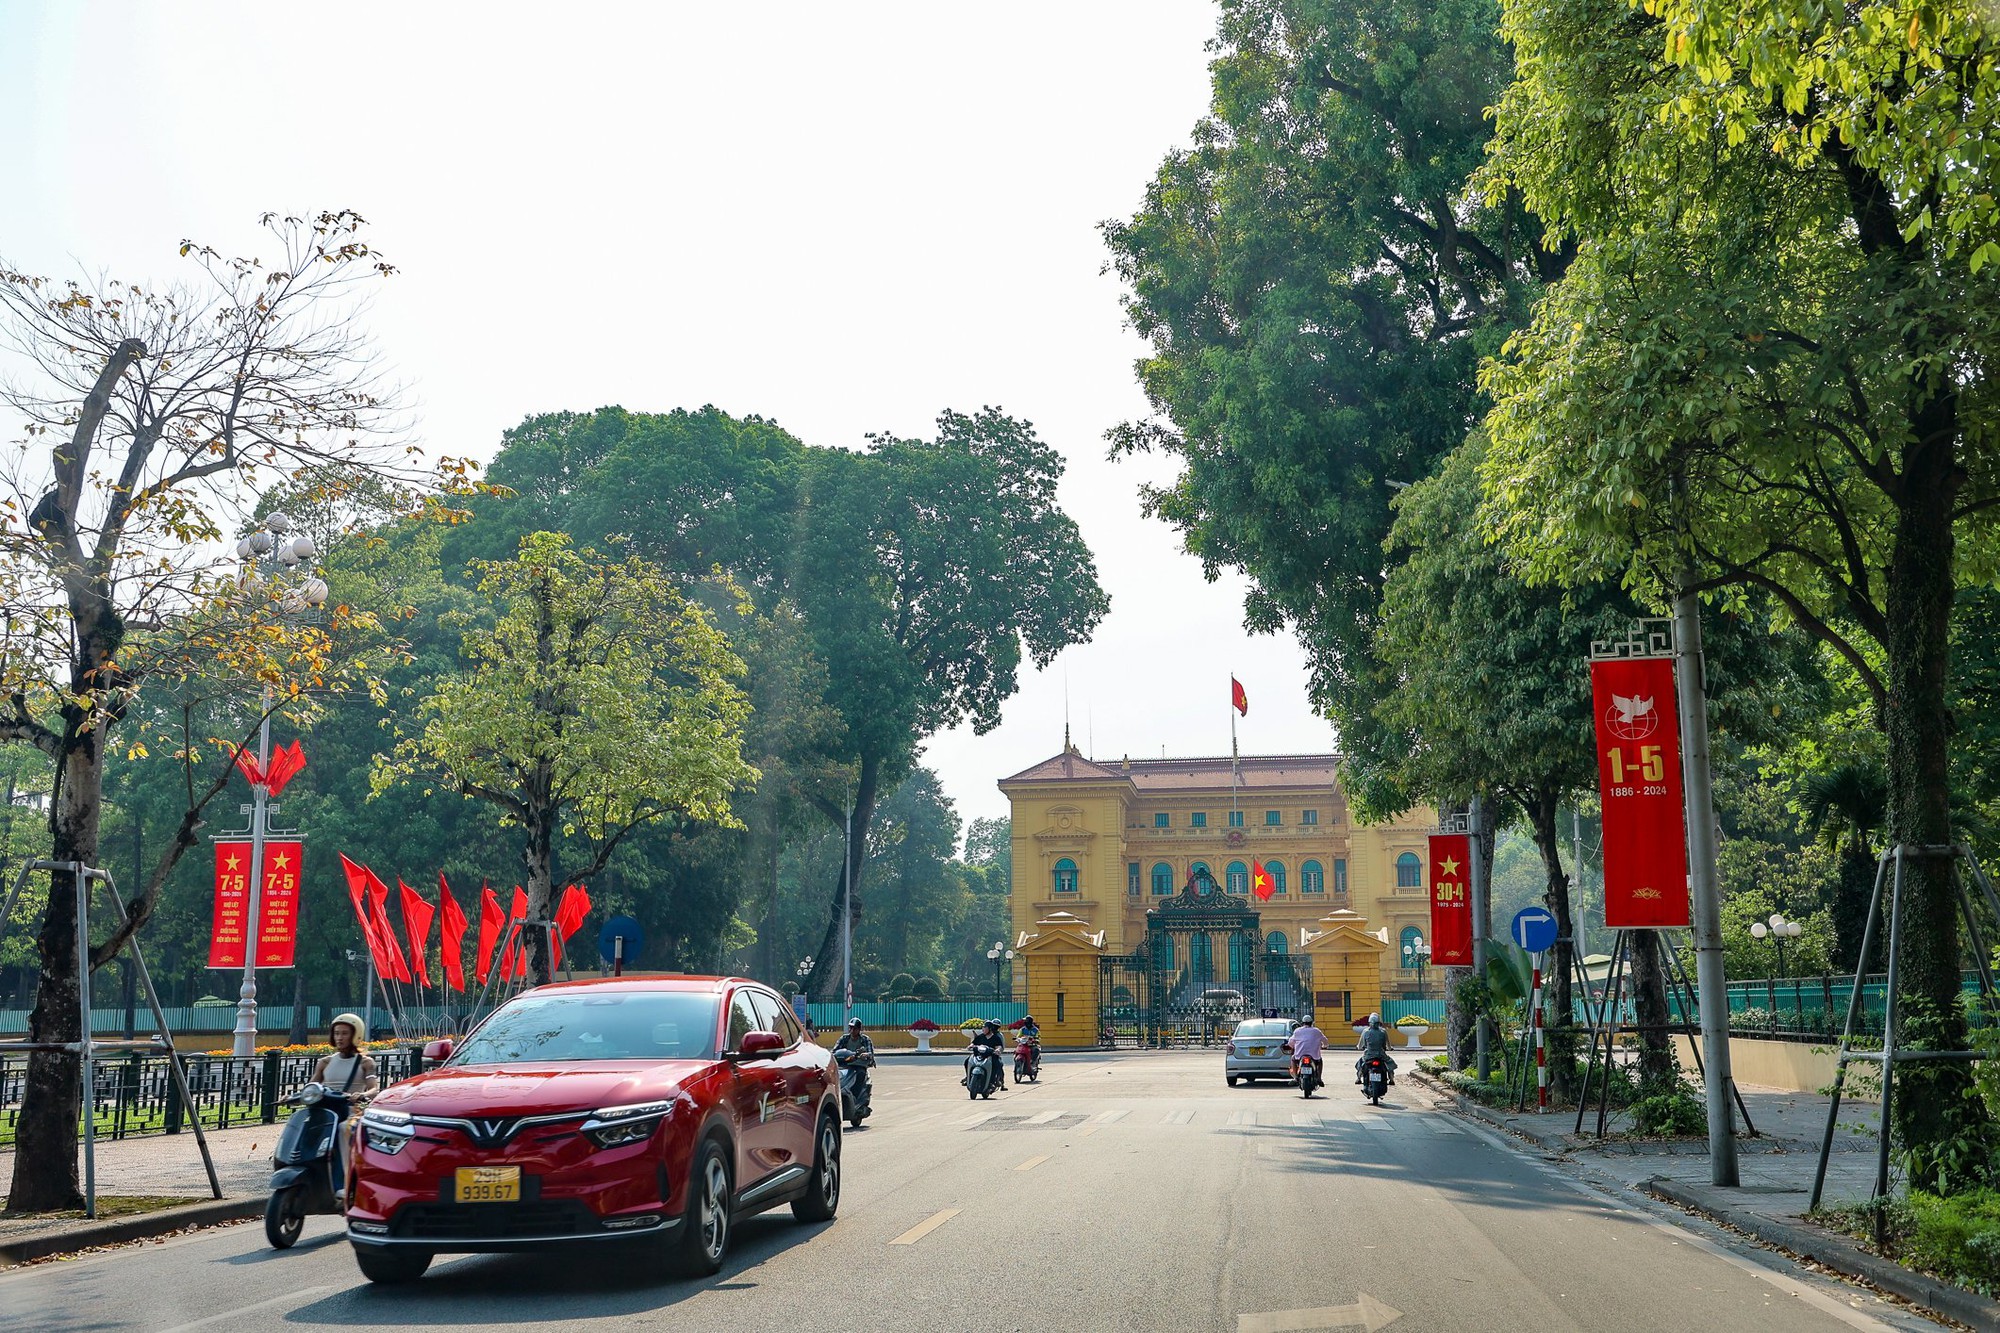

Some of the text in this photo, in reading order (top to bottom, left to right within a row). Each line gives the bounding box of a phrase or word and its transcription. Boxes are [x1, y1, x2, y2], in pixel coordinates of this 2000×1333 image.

[1607, 745, 1664, 784] 1-5
[1610, 787, 1634, 797] 1886
[1643, 786, 1667, 796] 2024
[220, 874, 244, 890] 7-5
[266, 874, 294, 890] 7-5
[1436, 882, 1464, 900] 30-4
[463, 1185, 512, 1200] 939.67
